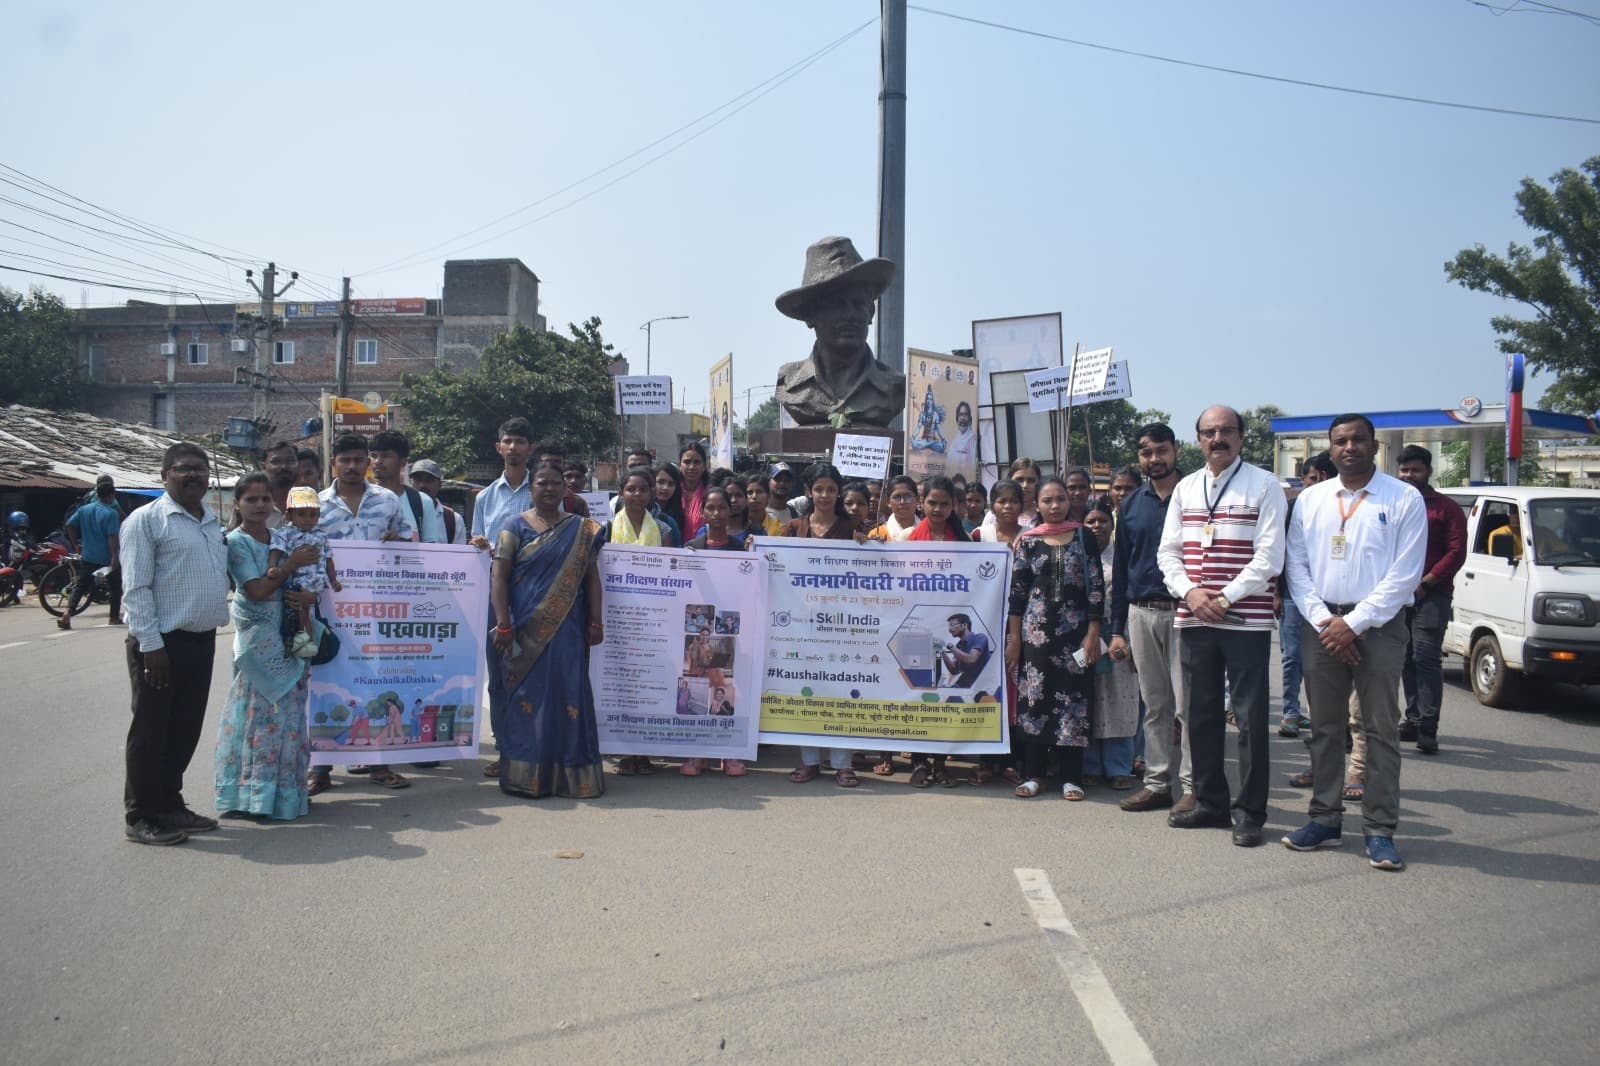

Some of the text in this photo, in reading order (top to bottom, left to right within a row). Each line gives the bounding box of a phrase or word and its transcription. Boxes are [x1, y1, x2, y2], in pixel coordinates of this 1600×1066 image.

[646, 556, 663, 564] India
[808, 557, 822, 566] जन
[824, 555, 849, 567] शिक्षण
[851, 556, 878, 568] संस्थान
[881, 558, 906, 569] विकास
[910, 558, 934, 569] भारती
[347, 568, 373, 578] शिक्षण
[376, 568, 399, 579] संस्थान
[402, 570, 426, 580] विकास
[606, 573, 693, 589] जन शिक्षण संस्थान
[897, 573, 971, 593] गतिविधि
[336, 602, 410, 619] स्वच्छता
[816, 612, 880, 626] Skill India
[378, 622, 459, 643] पखवाड़ा
[767, 667, 880, 684] #Kaushalkadashak
[769, 708, 795, 716] कार्यालय
[786, 697, 805, 706] कौशल
[806, 699, 824, 708] विकास
[900, 703, 919, 712] कौशल
[920, 704, 940, 713] विकास
[963, 706, 976, 714] भारत
[978, 706, 996, 714] सरकार
[824, 724, 844, 732] Email
[849, 725, 928, 736] jsskhunti@gmail.com
